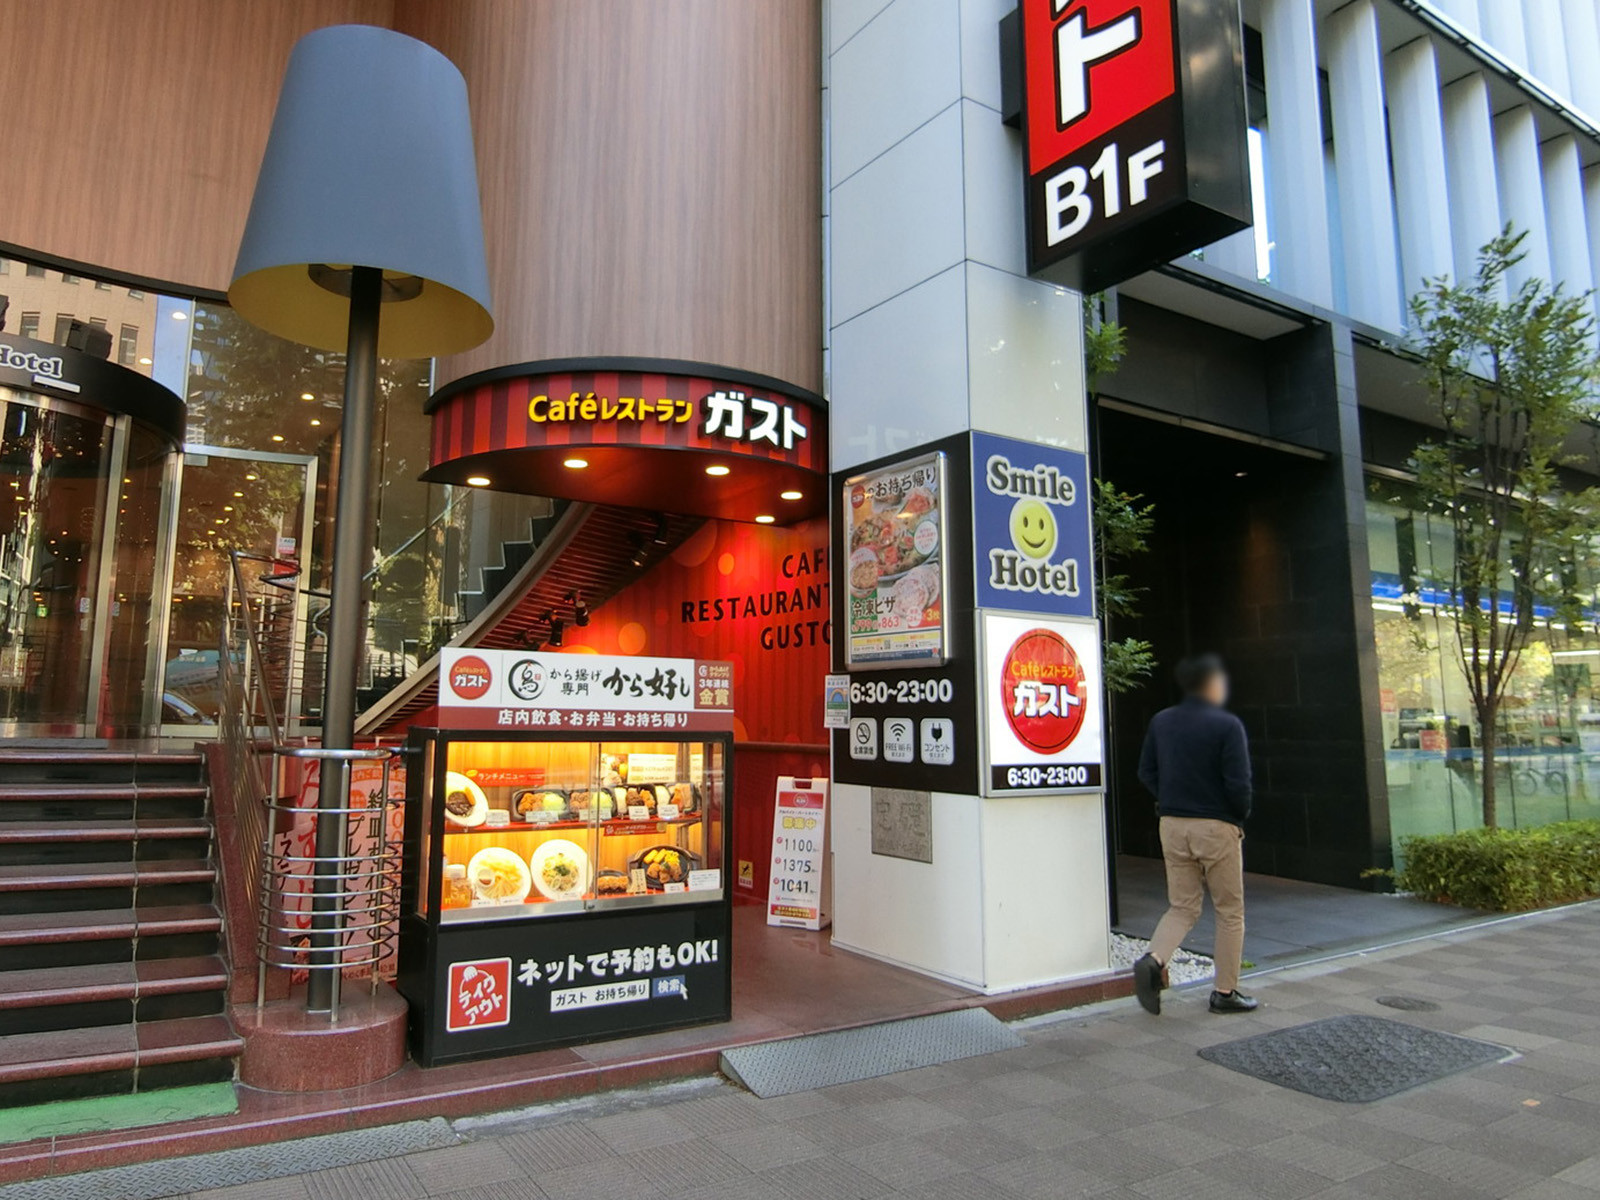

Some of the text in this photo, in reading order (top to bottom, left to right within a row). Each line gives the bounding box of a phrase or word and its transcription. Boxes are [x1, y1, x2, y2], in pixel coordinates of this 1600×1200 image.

[1055, 0, 1137, 124] ト
[1045, 139, 1165, 247] B1F
[705, 391, 807, 449] ガスト
[990, 460, 1074, 501] Smile
[782, 545, 829, 578] CAF
[993, 554, 1077, 592] Hotel
[454, 674, 488, 688] ガスト
[561, 682, 589, 696] 専門
[602, 666, 690, 701] から好し
[1014, 681, 1081, 718] ガスト
[784, 838, 813, 852] 1100
[783, 859, 811, 873] 1375
[458, 975, 496, 1009] テイク
[465, 993, 503, 1024] アウト
[555, 991, 588, 1006] ガスト
[594, 984, 646, 1002] お持ち帰り
